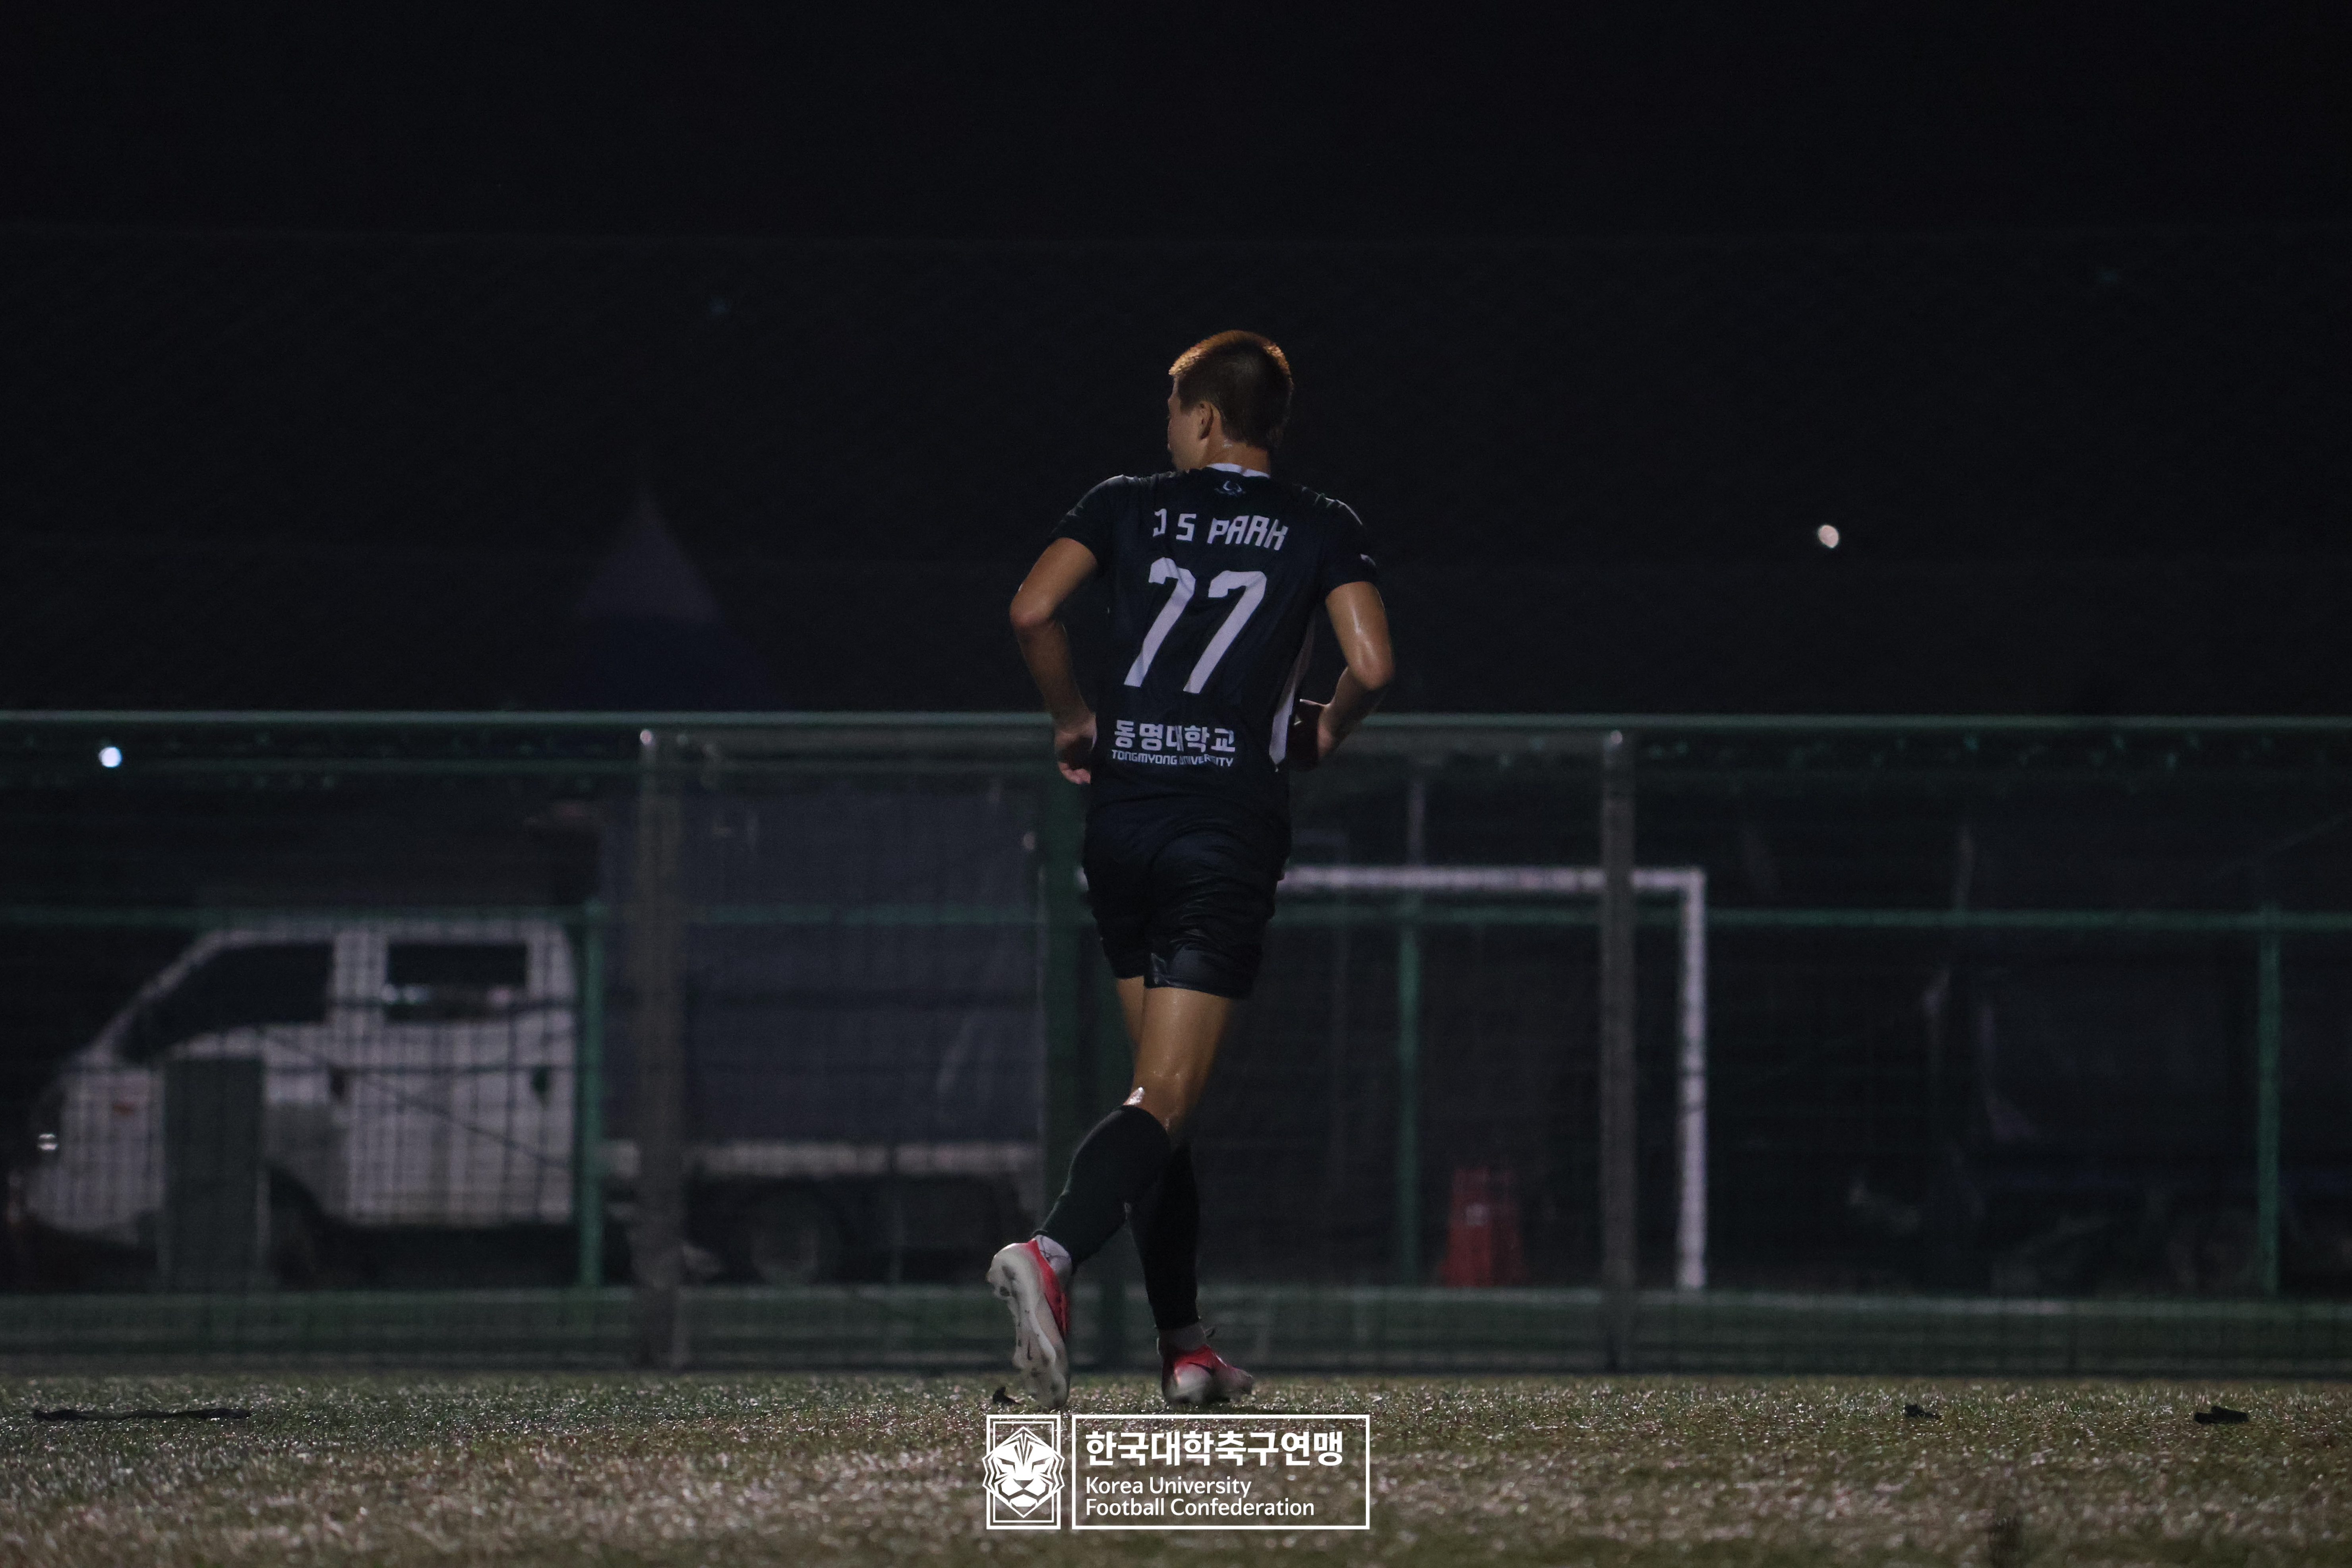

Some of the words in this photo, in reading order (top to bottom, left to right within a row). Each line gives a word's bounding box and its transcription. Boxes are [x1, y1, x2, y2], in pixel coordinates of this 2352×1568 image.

[1153, 508, 1167, 537] J
[1176, 513, 1196, 541] S
[1207, 515, 1288, 551] PARK
[1124, 557, 1267, 694] 77
[1114, 720, 1235, 753] 동명대학교
